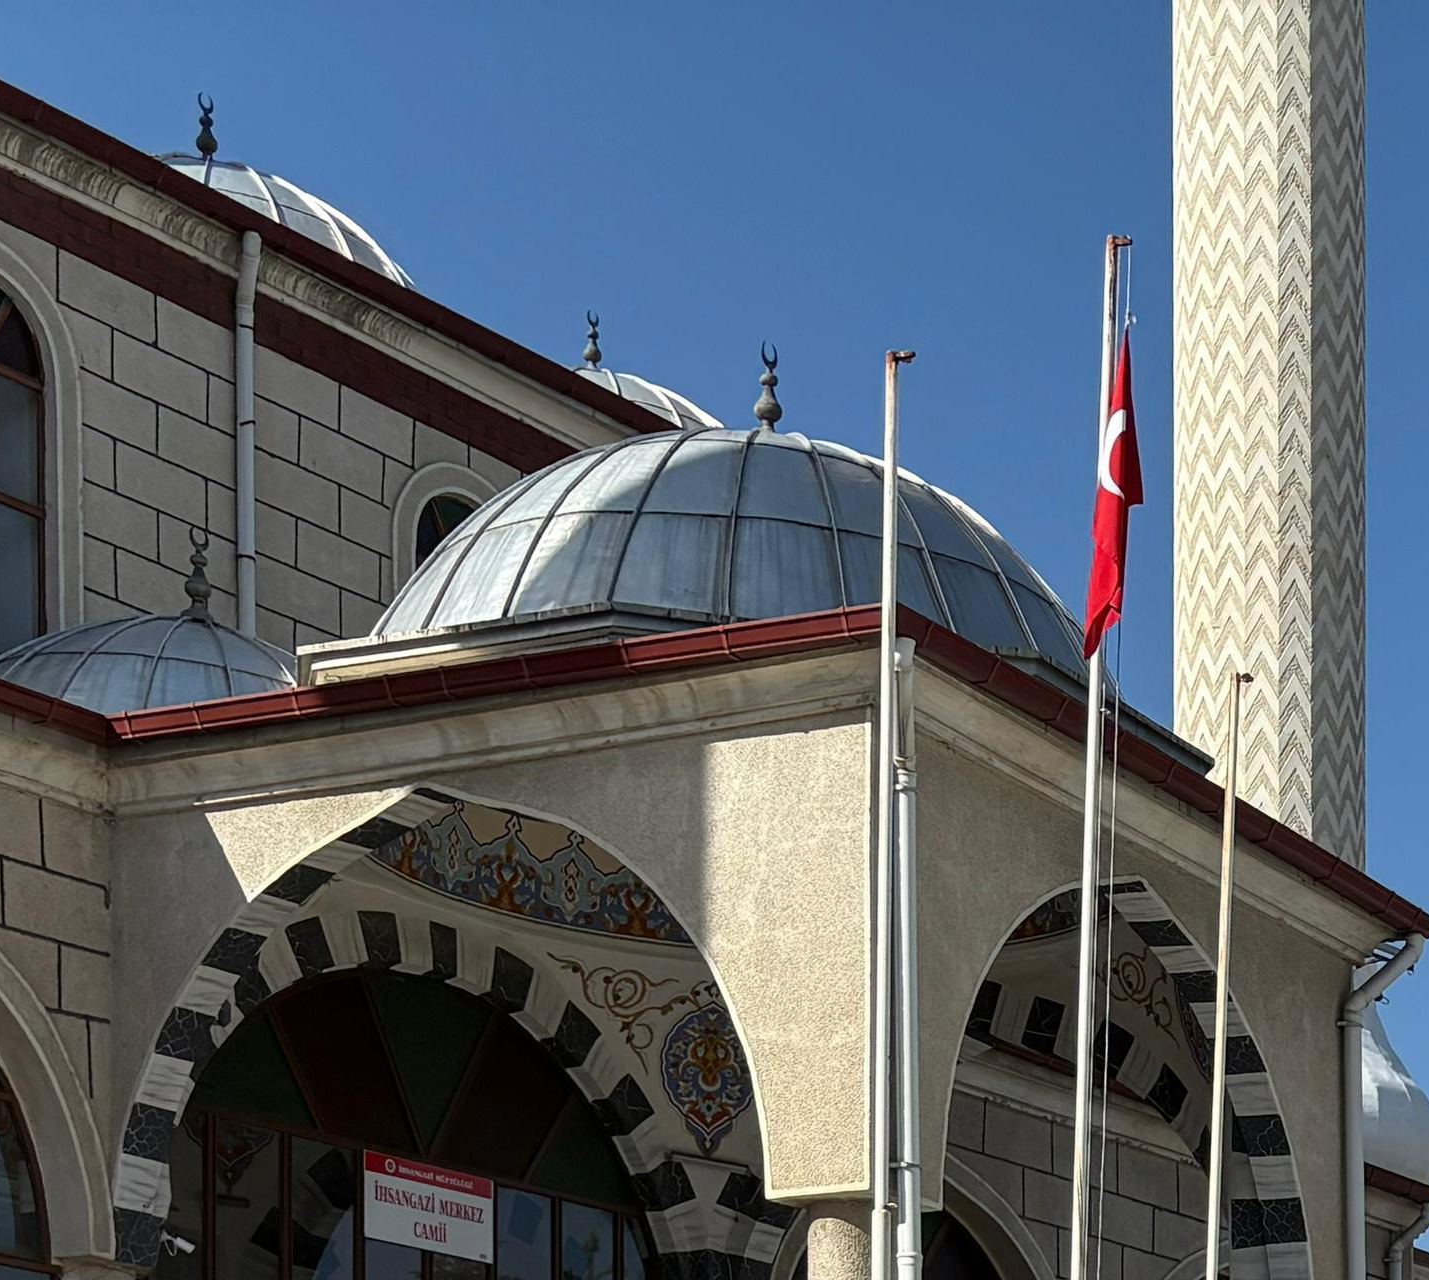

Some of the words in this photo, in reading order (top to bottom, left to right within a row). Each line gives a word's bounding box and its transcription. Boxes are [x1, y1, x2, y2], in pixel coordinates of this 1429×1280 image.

[374, 1180, 435, 1213] İHSANGAZİ
[439, 1199, 484, 1224] MERKEZ
[414, 1221, 447, 1244] CAMİİ
